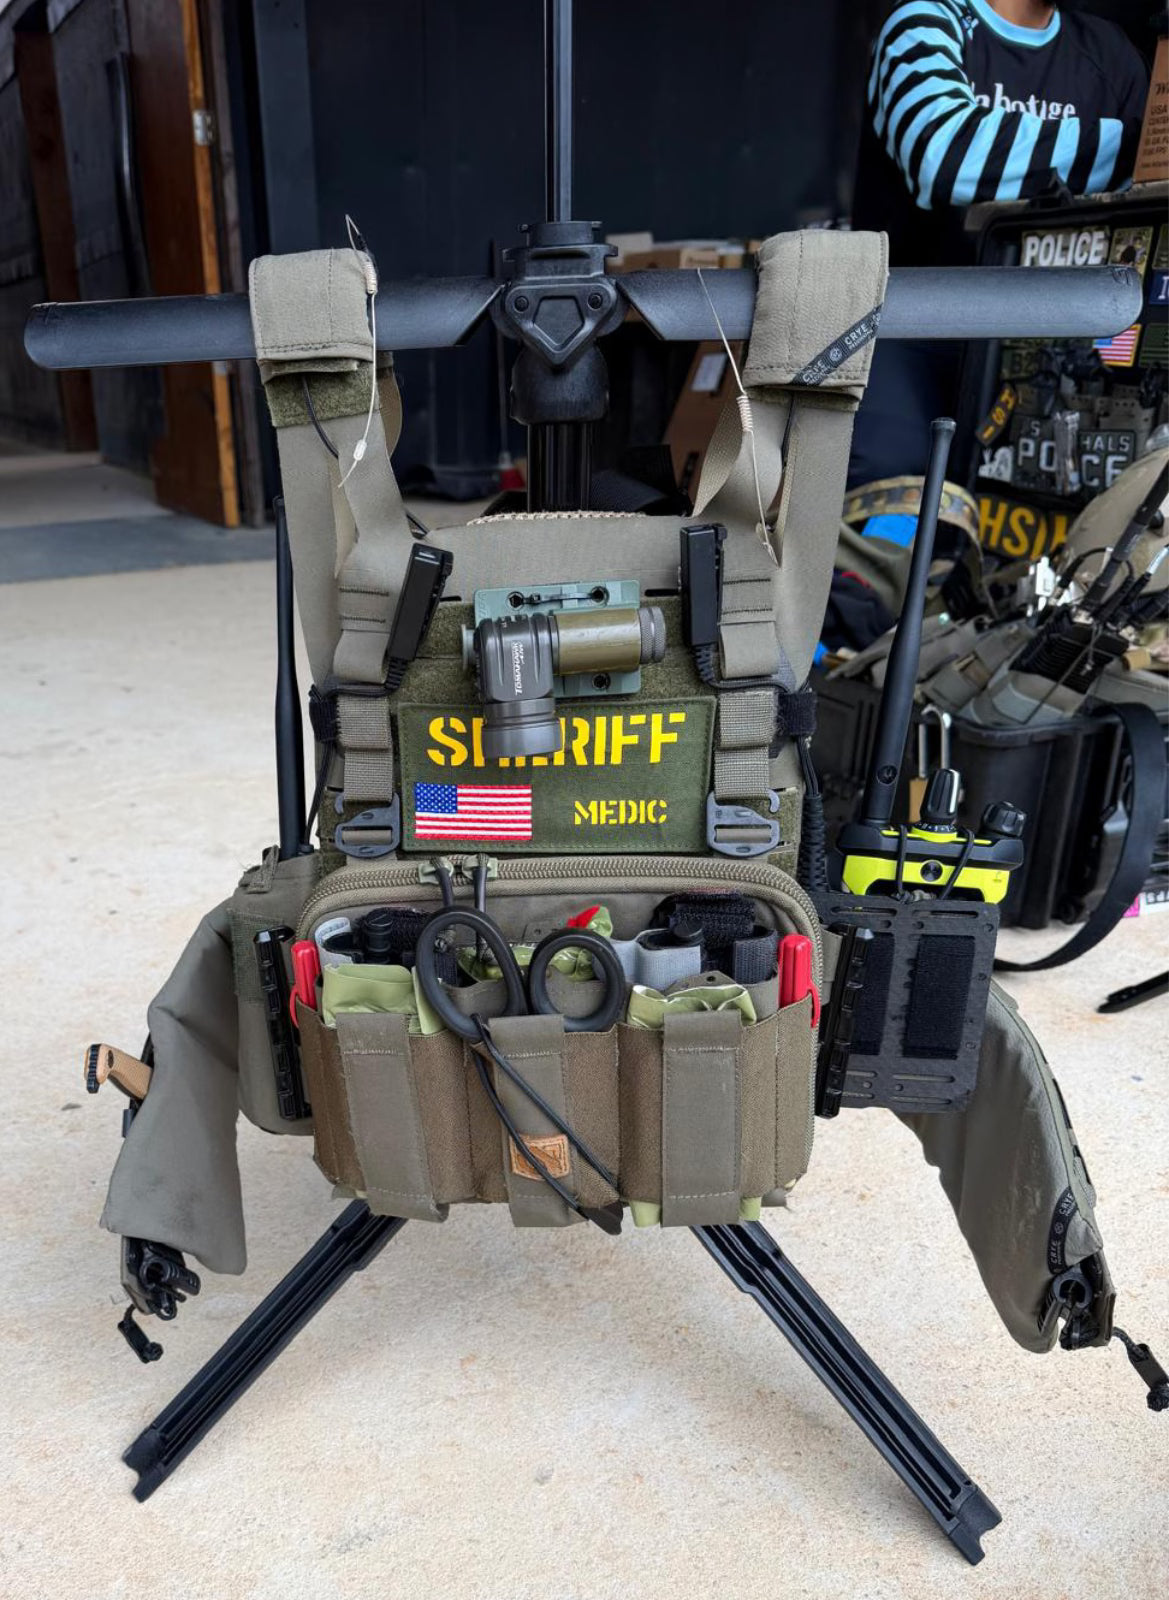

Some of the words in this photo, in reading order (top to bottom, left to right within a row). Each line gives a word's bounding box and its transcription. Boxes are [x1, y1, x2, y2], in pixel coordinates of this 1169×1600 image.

[971, 81, 1076, 120] abotge
[1023, 231, 1106, 266] POLICE
[844, 323, 869, 346] CRYE
[427, 712, 687, 768] SRIFF
[574, 799, 668, 825] MEDIC
